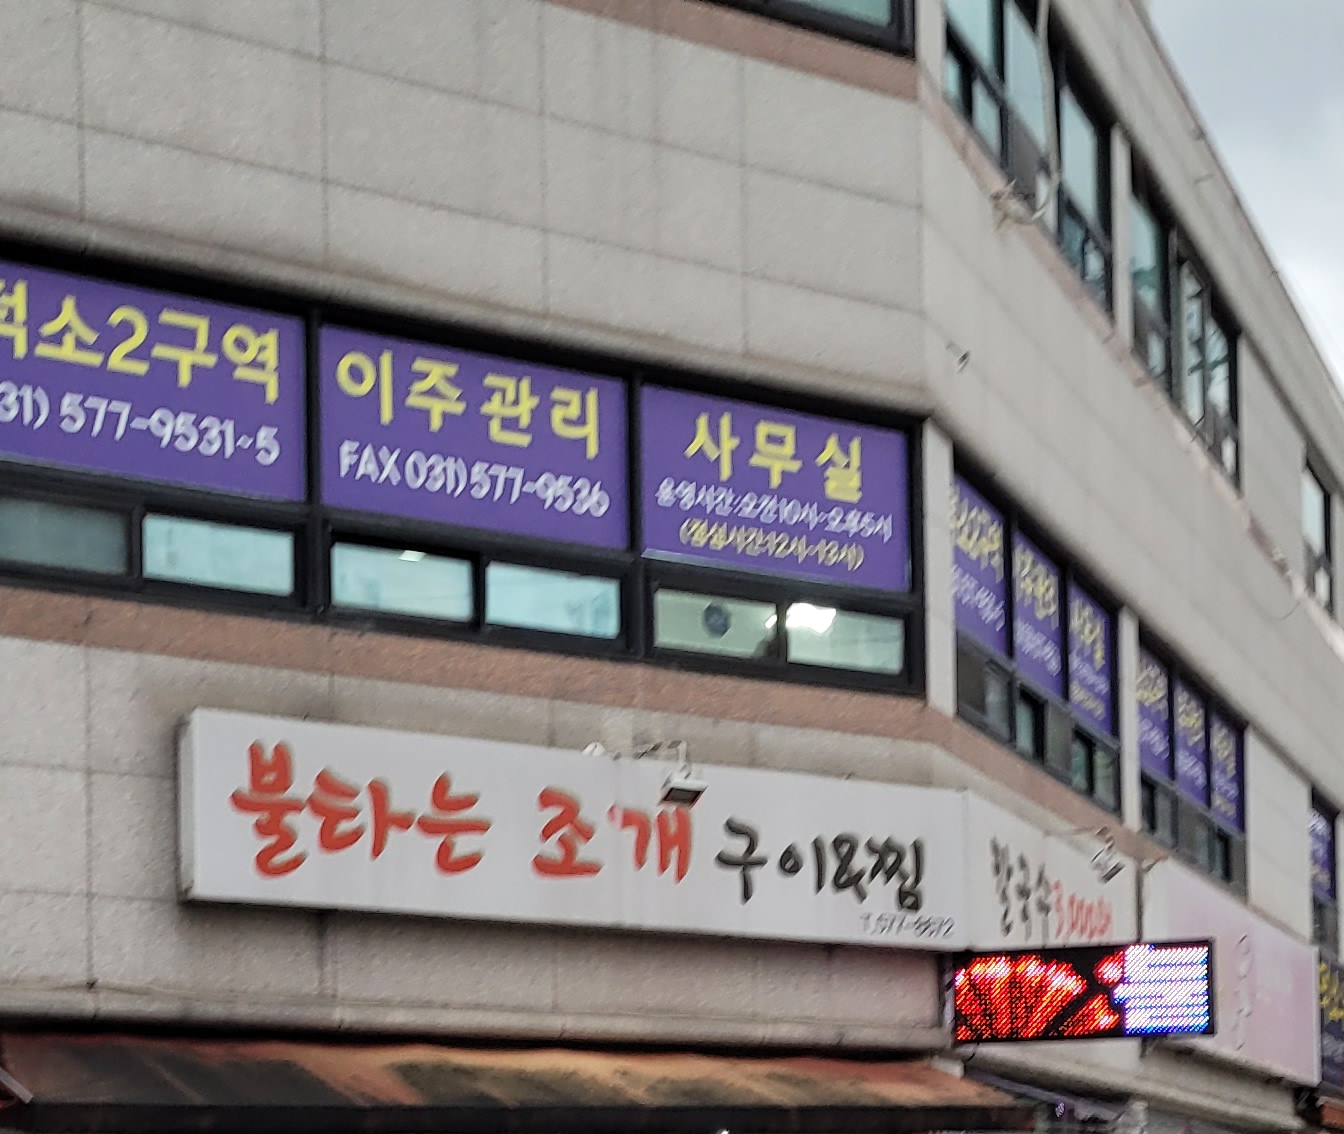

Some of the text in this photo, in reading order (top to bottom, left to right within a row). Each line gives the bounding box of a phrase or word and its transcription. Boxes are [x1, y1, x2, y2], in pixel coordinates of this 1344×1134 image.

[339, 439, 402, 486] FAX
[683, 411, 862, 503] 사무실
[229, 739, 493, 879] 불타는
[530, 785, 693, 884] 조개
